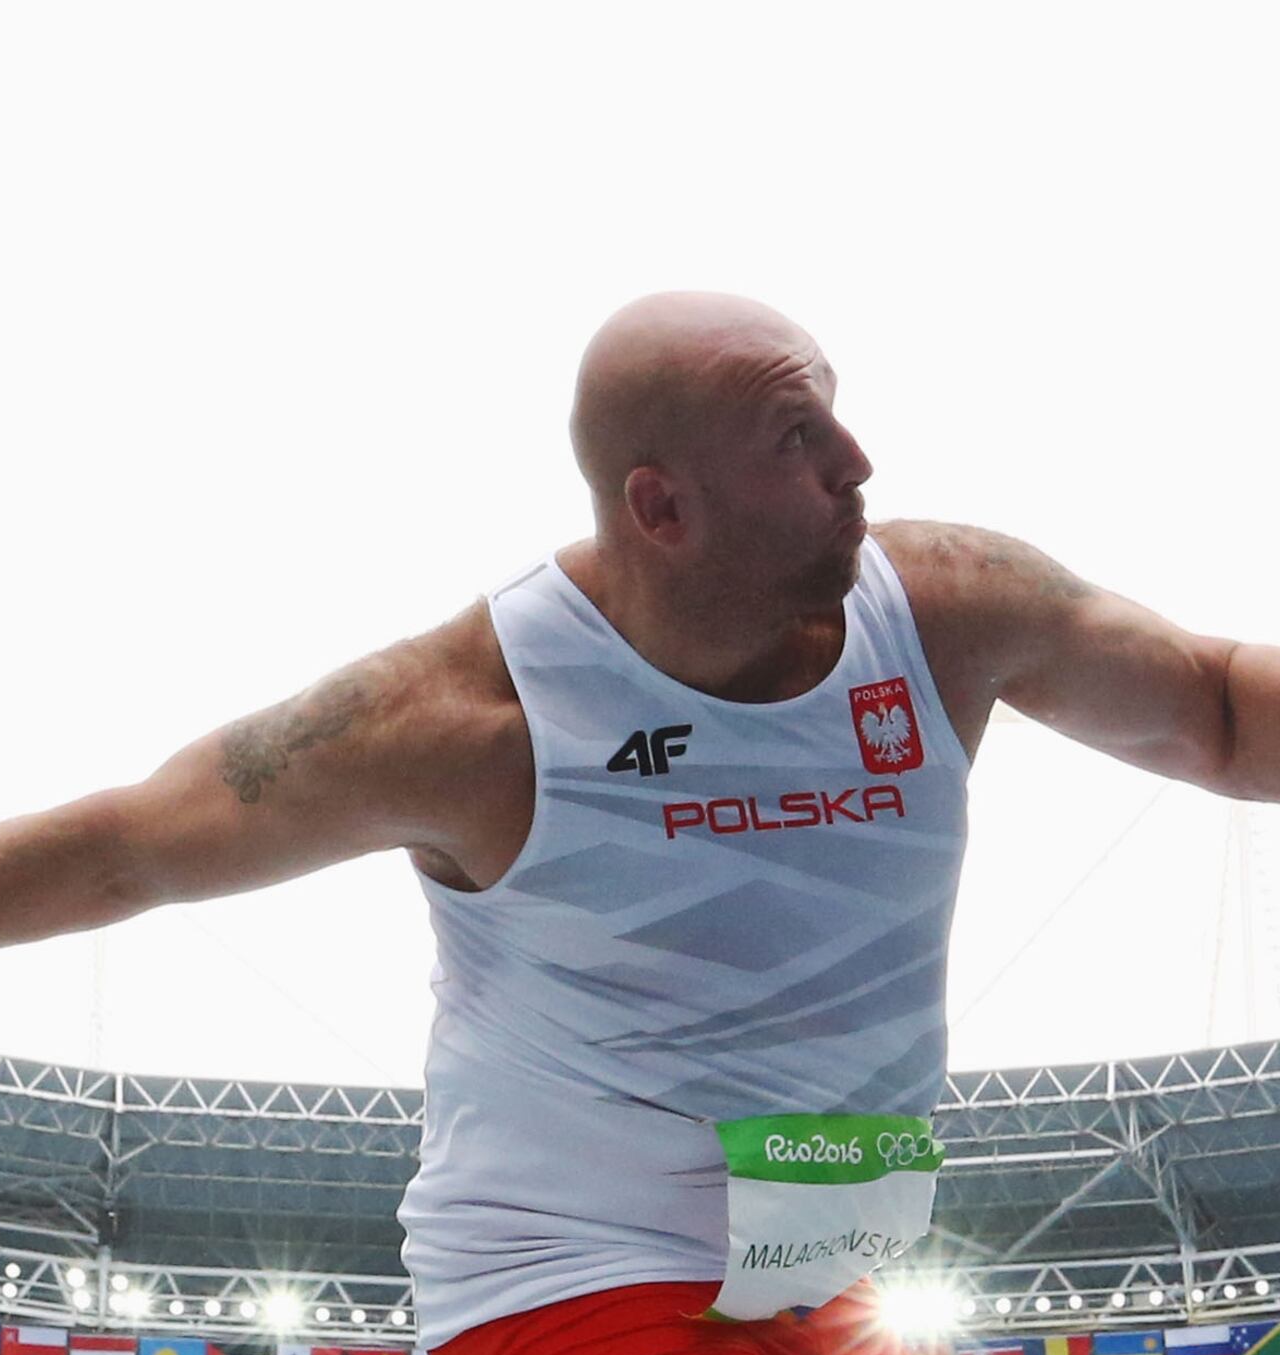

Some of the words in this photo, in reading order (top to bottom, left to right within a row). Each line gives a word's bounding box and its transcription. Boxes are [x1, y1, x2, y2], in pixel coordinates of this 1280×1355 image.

[854, 683, 903, 703] POLSKA
[606, 724, 693, 777] 4F
[662, 784, 906, 840] POLSKA
